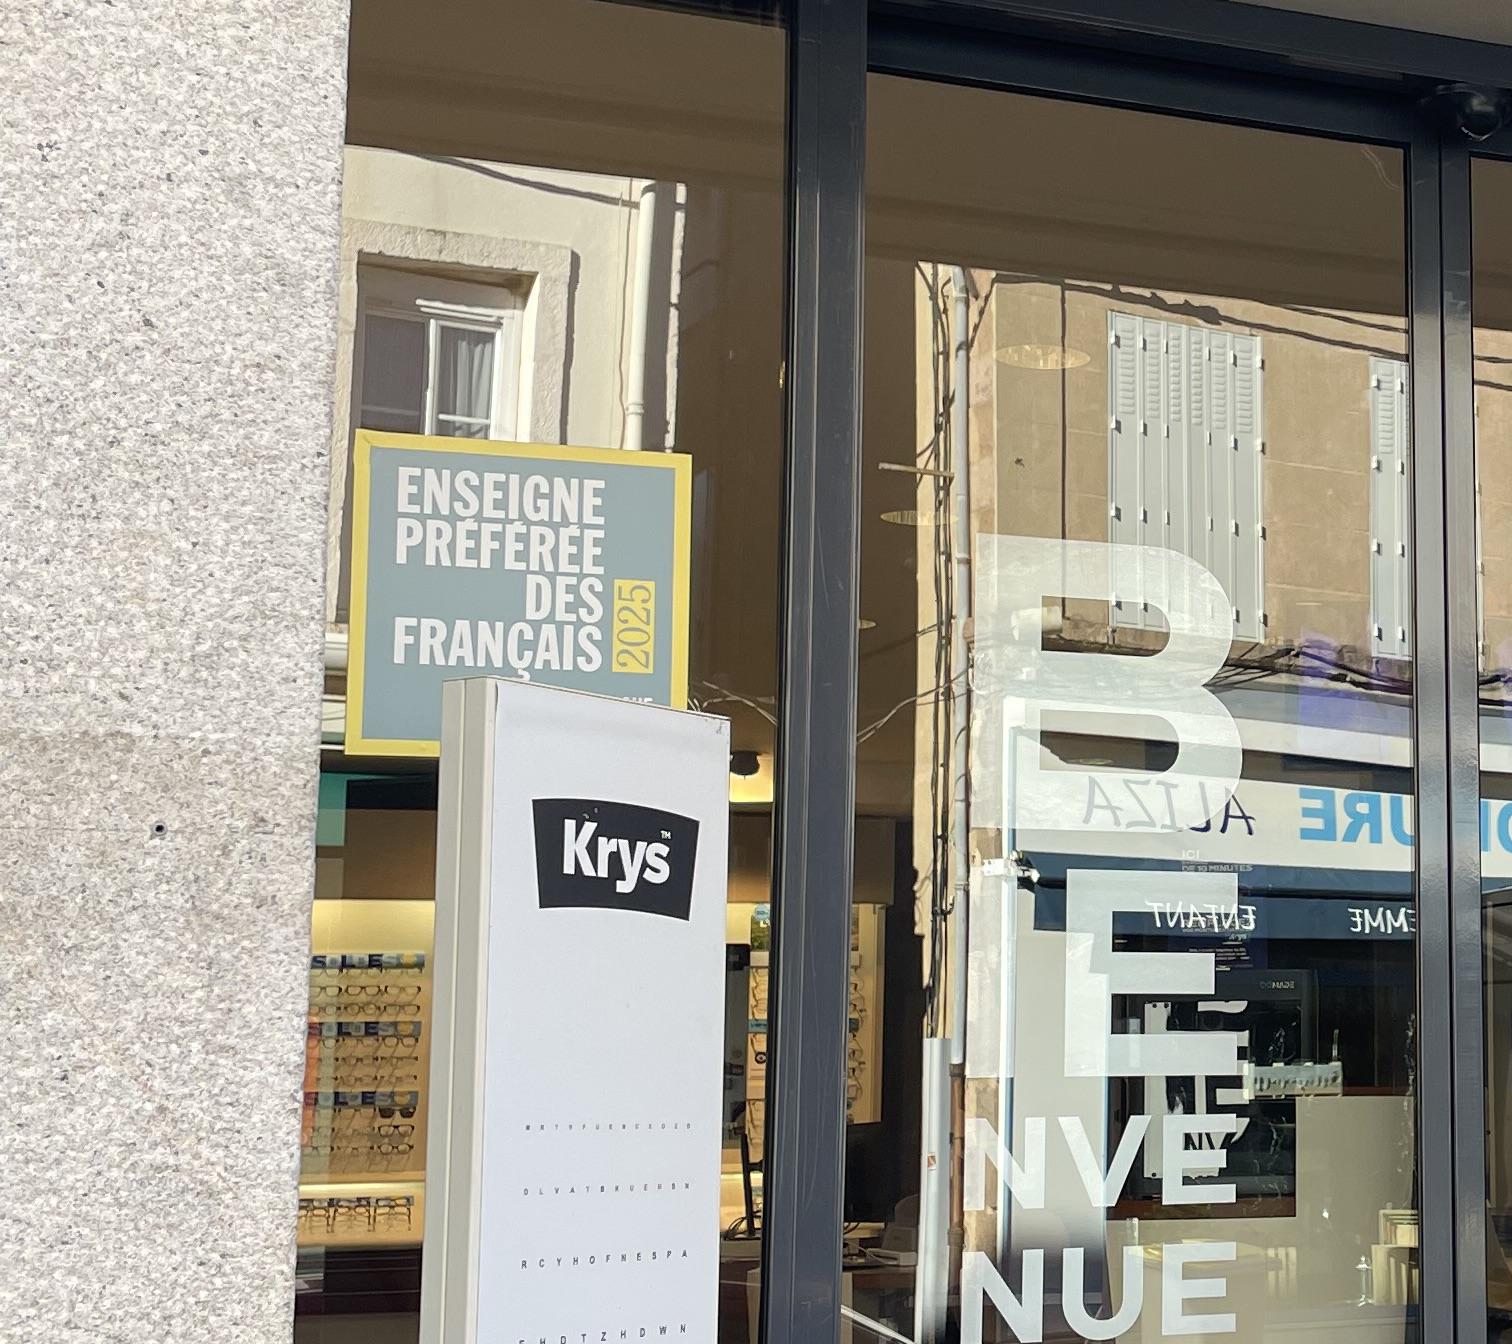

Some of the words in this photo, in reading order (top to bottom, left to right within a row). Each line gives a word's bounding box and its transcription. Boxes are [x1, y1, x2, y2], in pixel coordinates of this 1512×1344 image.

[398, 466, 605, 526] ENSEIGNE
[395, 515, 605, 575] PRÉFÉRÉE
[526, 575, 603, 623] DES
[616, 583, 651, 670] 2025
[393, 616, 602, 680] FRANÇAIS
[970, 532, 1243, 834] B
[562, 819, 671, 895] Krys
[963, 1114, 1237, 1211] NVE
